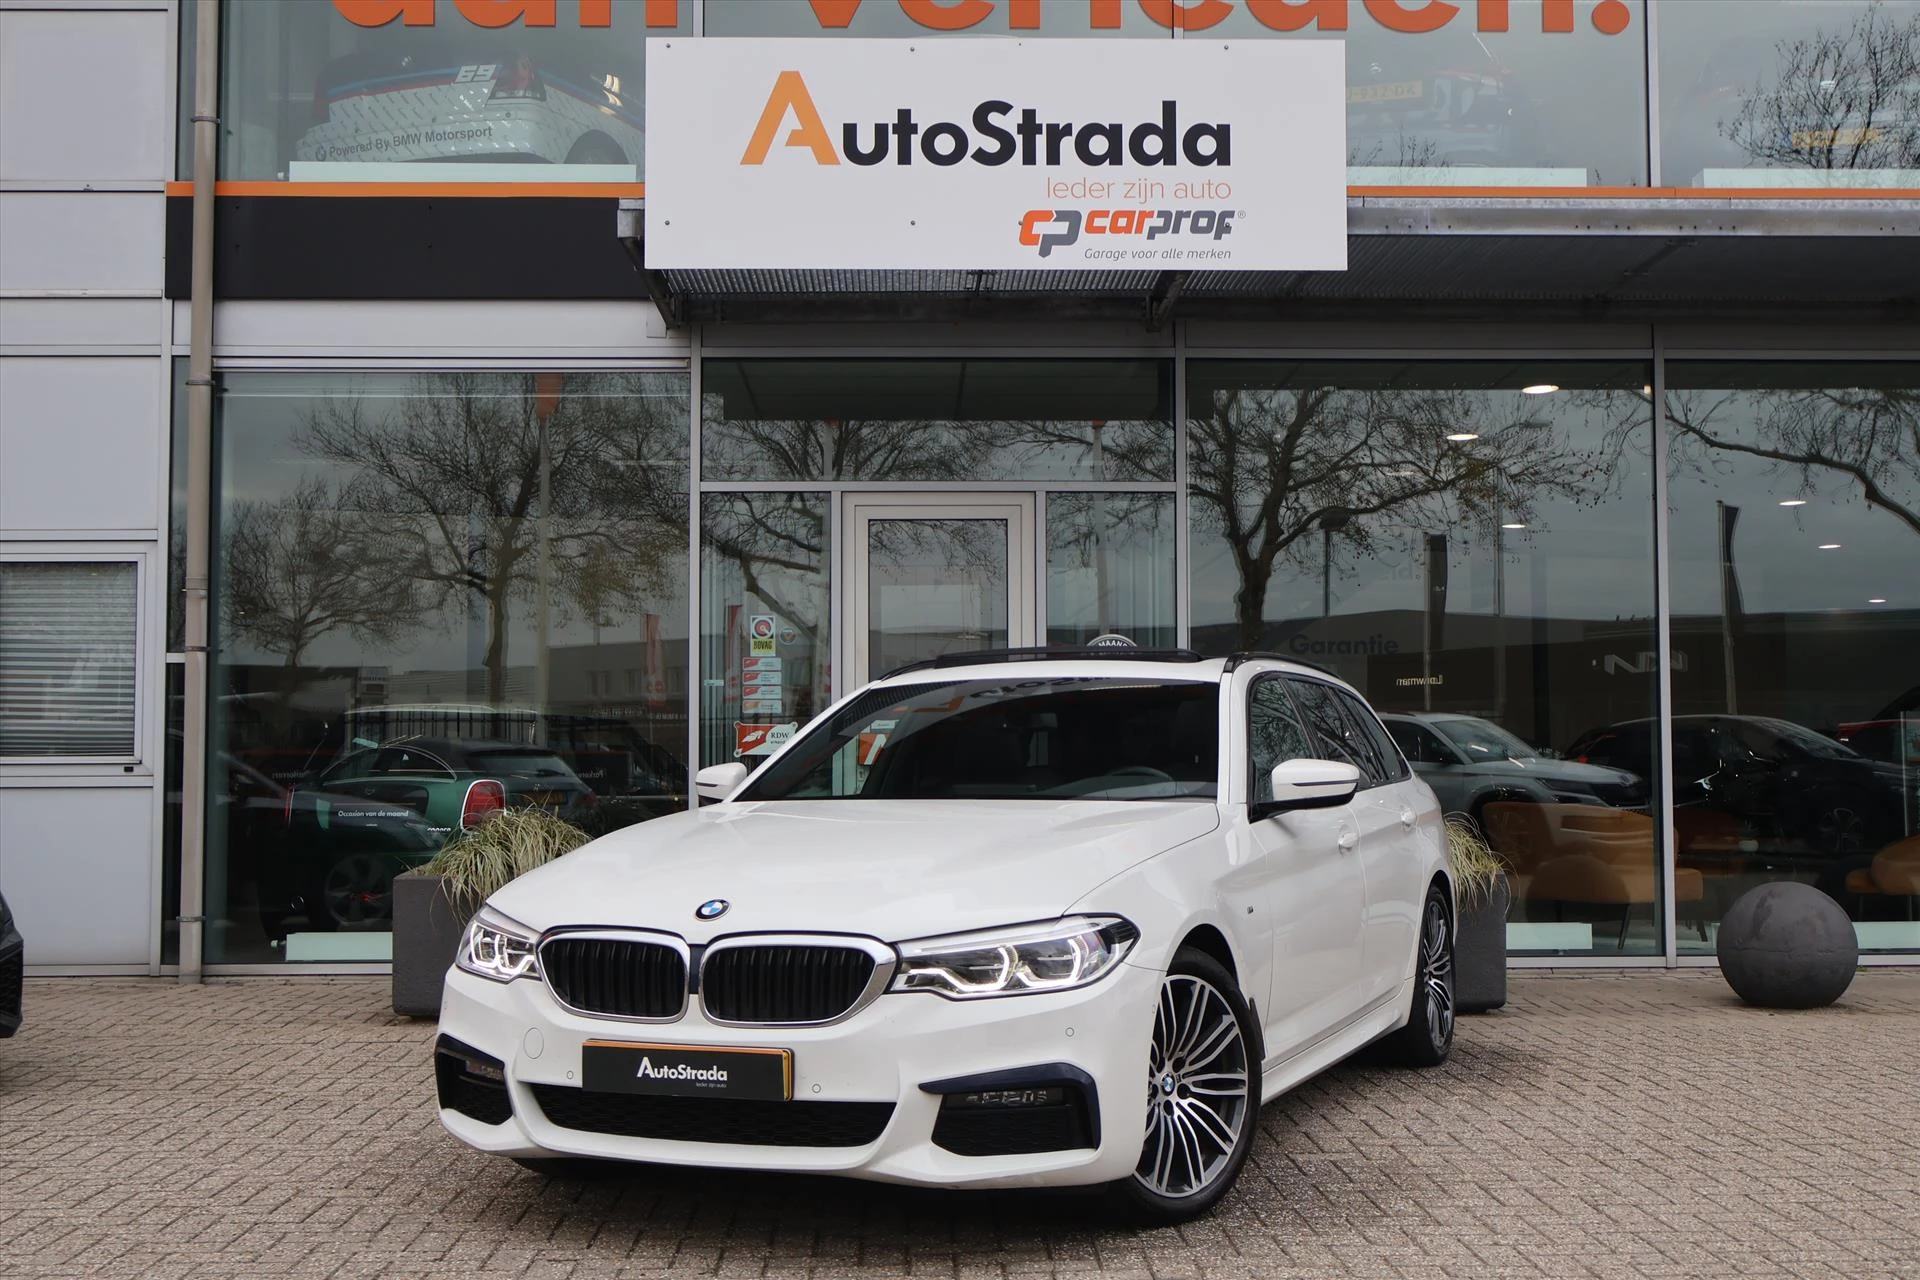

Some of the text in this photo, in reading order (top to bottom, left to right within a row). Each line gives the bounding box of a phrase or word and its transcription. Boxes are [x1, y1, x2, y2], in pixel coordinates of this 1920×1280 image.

[454, 64, 496, 83] 69
[740, 71, 1231, 166] AutoStrada
[329, 126, 492, 158] Powered By BMW Motorsport
[1047, 177, 1231, 204] Ieder zijn auto
[1084, 248, 1231, 260] Garage voor alle merken
[753, 640, 773, 650] BOVAG
[1289, 634, 1398, 654] Garantie
[637, 1056, 727, 1081] AutoStrada
